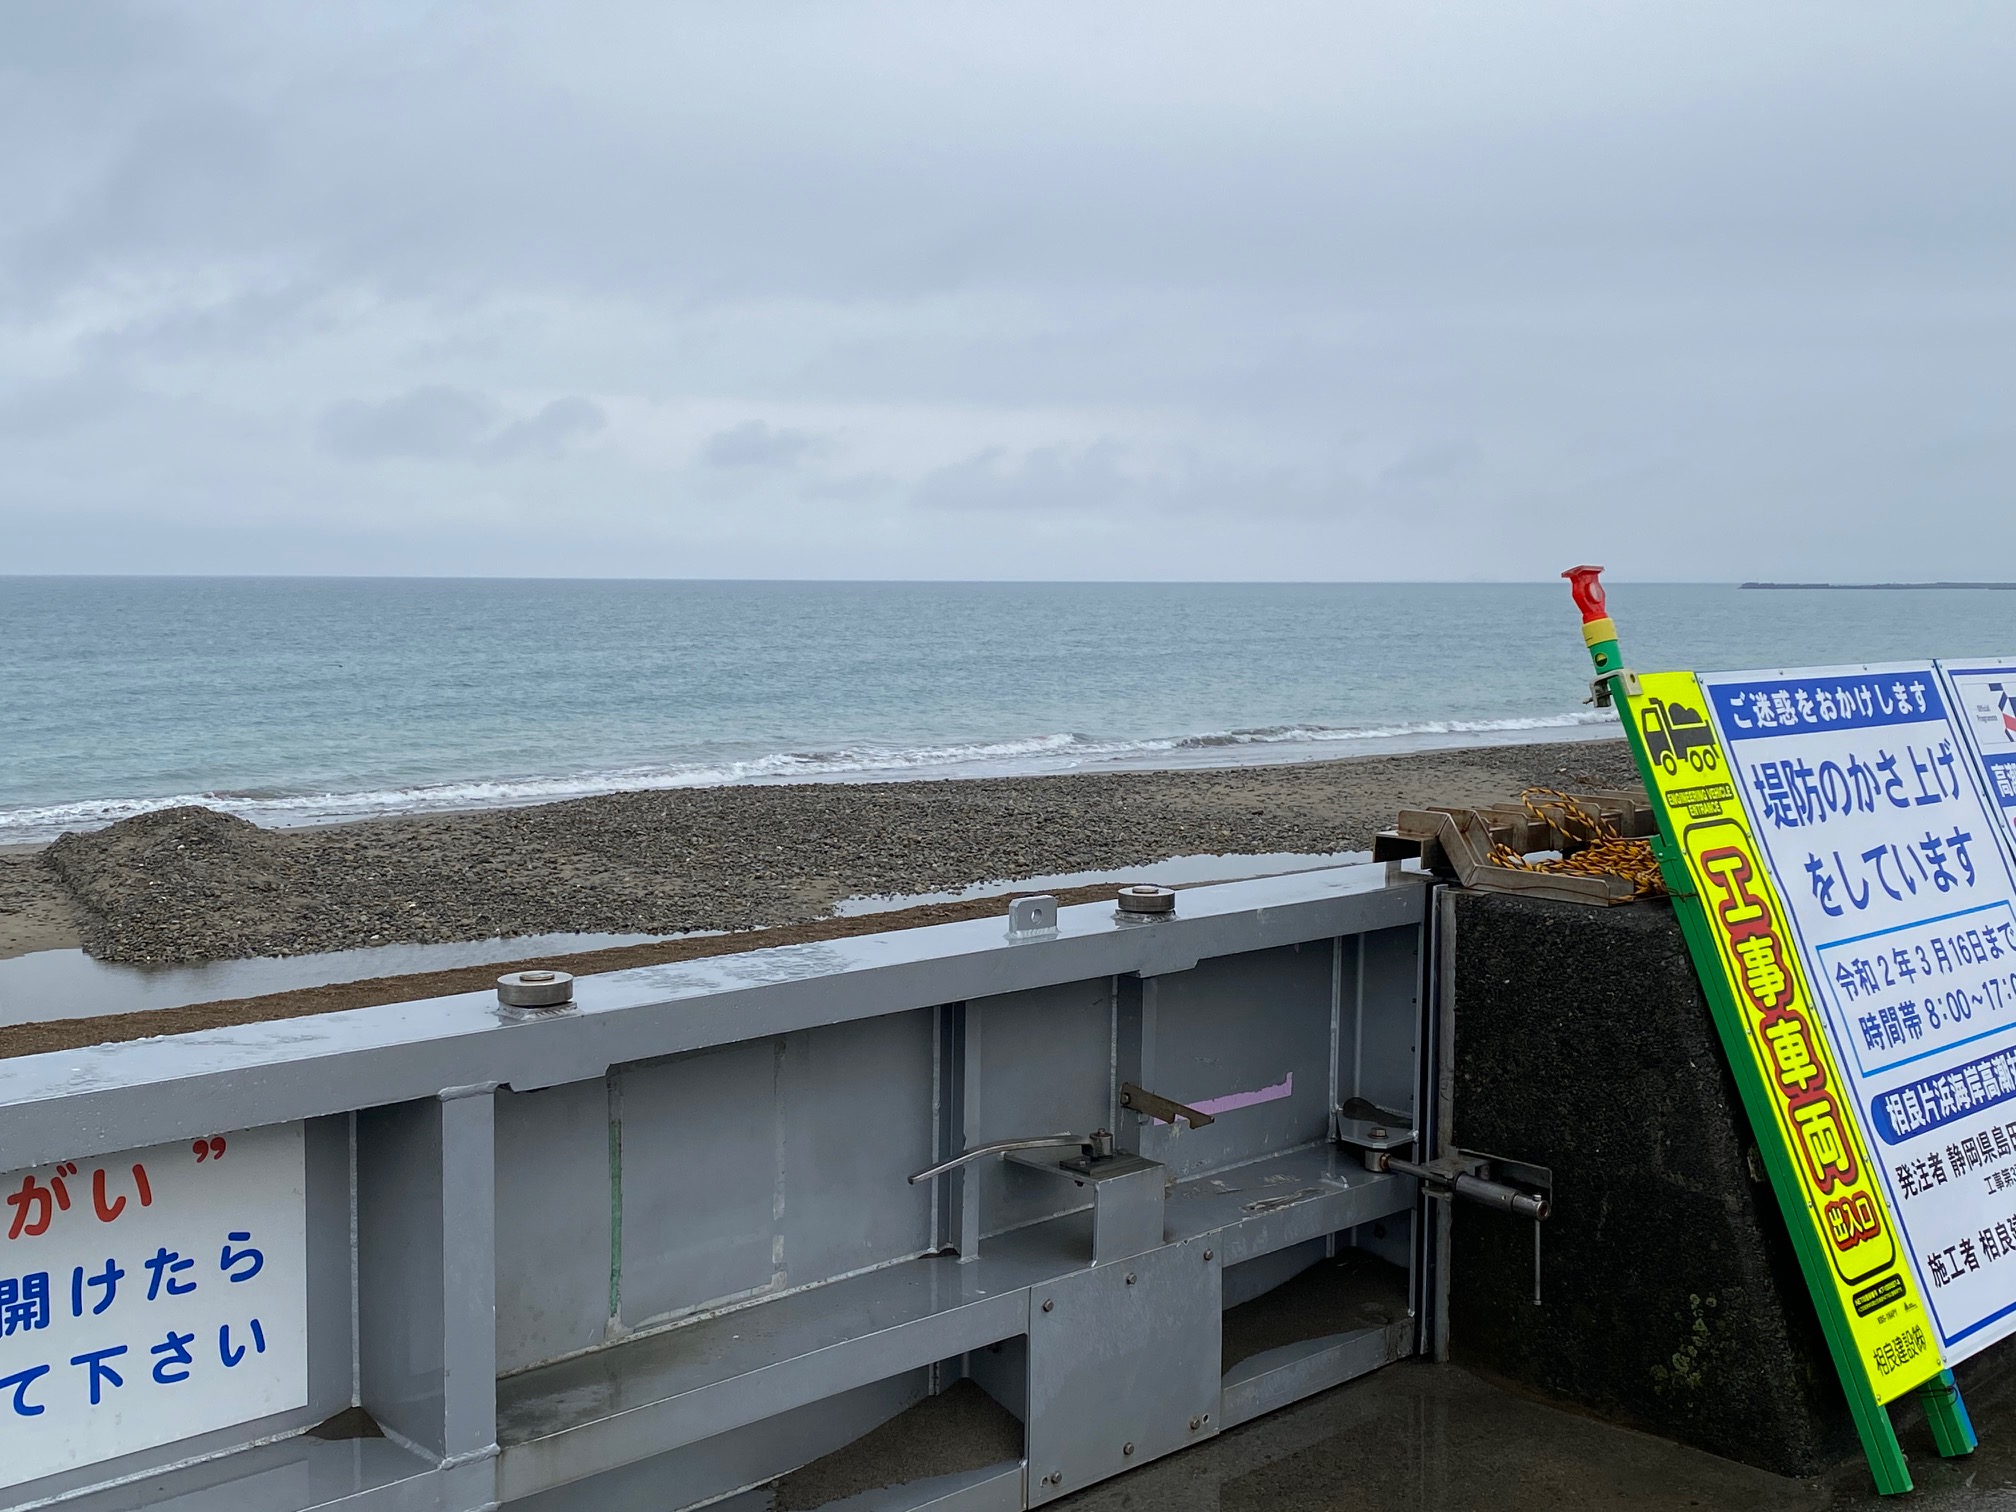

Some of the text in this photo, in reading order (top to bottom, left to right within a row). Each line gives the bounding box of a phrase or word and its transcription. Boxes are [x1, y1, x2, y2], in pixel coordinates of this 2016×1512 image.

[1730, 680, 1926, 728] ご迷惑をおかけします
[1667, 785, 1733, 806] ENGINEERING VEHICLE
[1688, 801, 1722, 816] ENTRANCE
[1751, 738, 1959, 829] 堤防のかさ上げ
[1803, 826, 1975, 917] をしています
[1836, 922, 2016, 1001] 令和2年3月16日まで
[1704, 852, 1851, 1185] 工事車両
[1858, 1000, 1922, 1050] 時間帯
[1895, 1152, 1948, 1200] 発注者
[1984, 1163, 2016, 1195] 工事第3
[1829, 1196, 1876, 1244] 出入口
[0, 1232, 264, 1338] 開けたら
[1927, 1237, 1980, 1288] 施工者
[0, 1318, 266, 1416] て下さい
